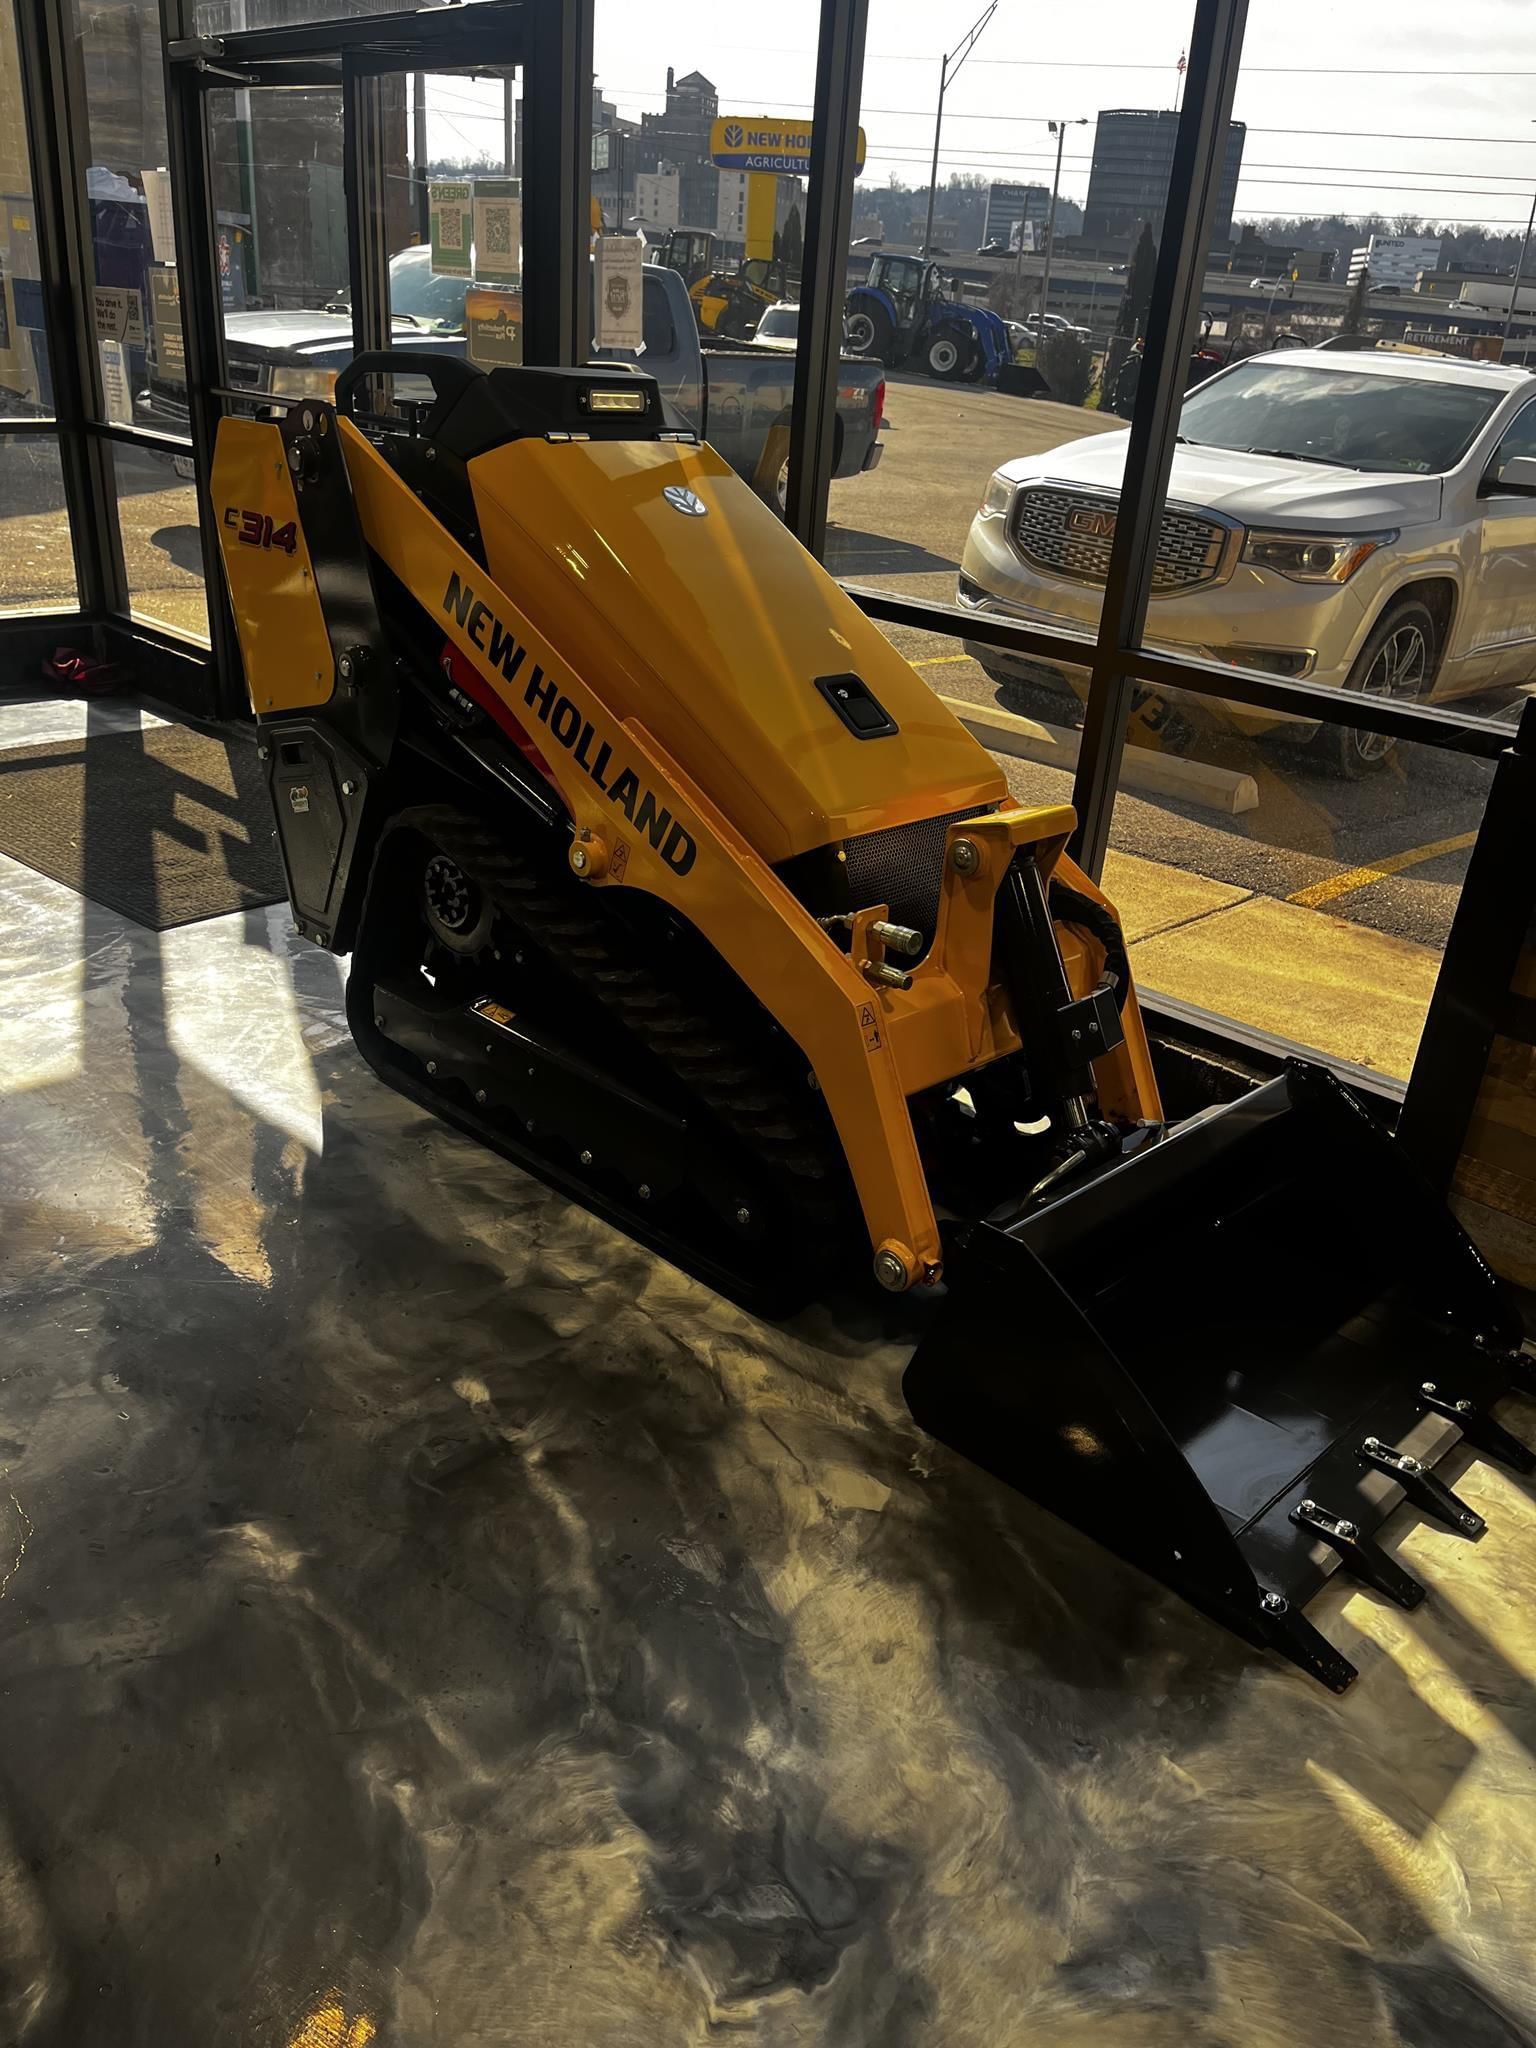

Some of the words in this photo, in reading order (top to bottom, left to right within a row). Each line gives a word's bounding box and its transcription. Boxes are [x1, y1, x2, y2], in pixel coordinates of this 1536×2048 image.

[747, 131, 782, 148] NEW
[784, 133, 812, 150] HO
[746, 156, 810, 170] AGRICULTU
[1406, 332, 1470, 345] RETIREMENT
[1069, 509, 1118, 538] GM
[441, 571, 529, 684] NEW
[523, 663, 697, 877] HOLLAND
